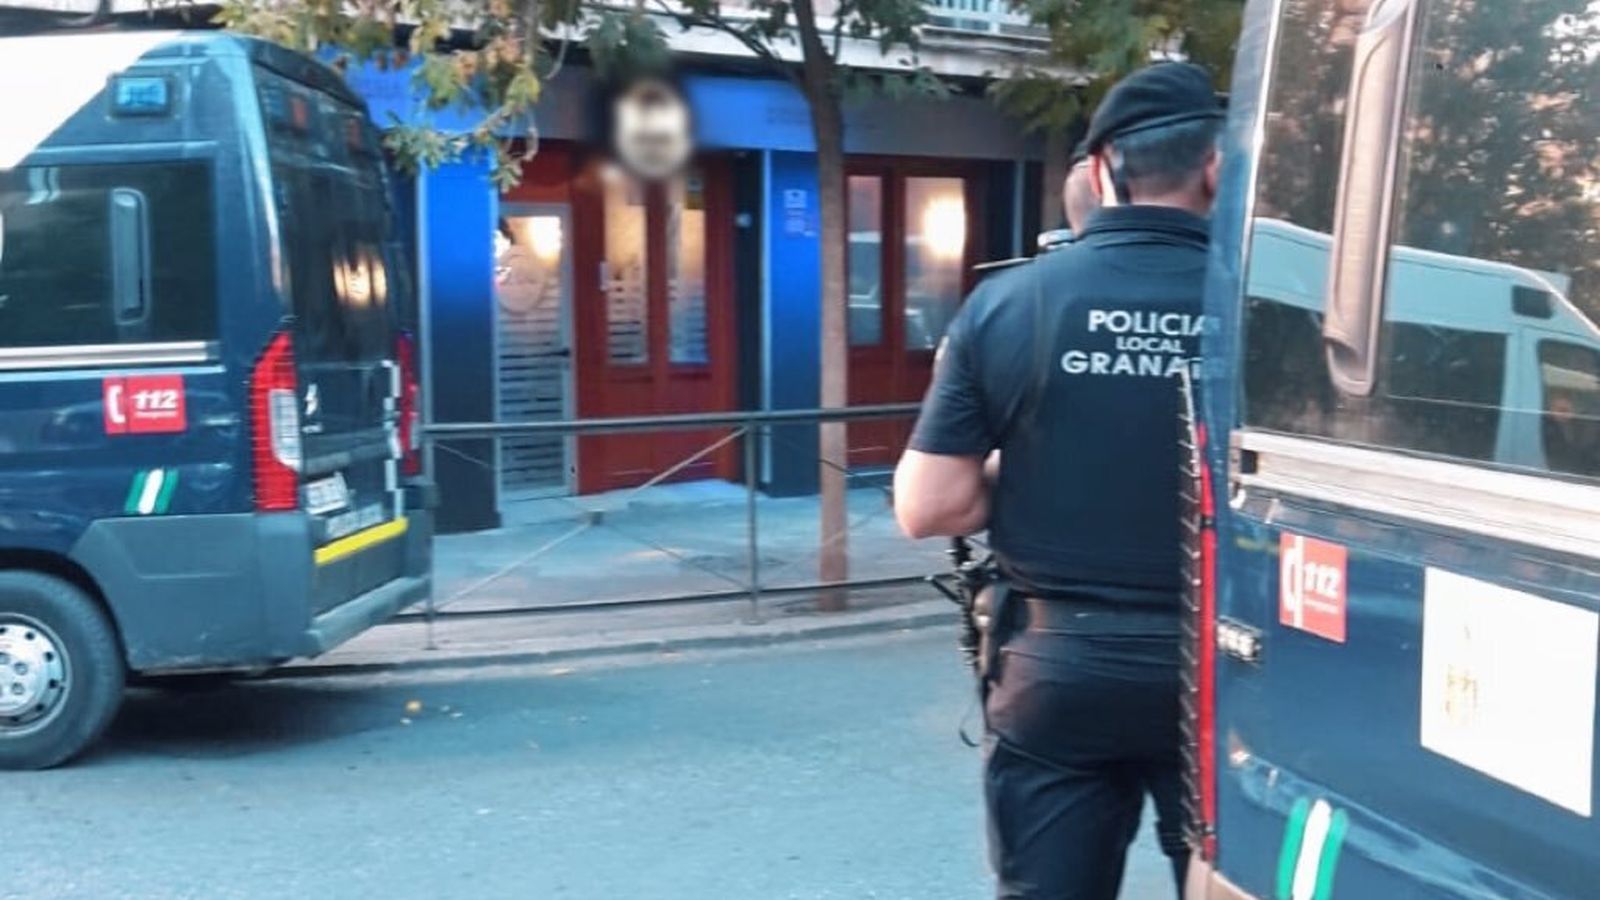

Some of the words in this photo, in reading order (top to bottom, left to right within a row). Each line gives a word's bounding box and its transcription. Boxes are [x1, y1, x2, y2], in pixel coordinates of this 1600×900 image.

[1115, 336, 1186, 353] LOCAL
[131, 389, 178, 410] 112
[1303, 561, 1341, 599] 112
